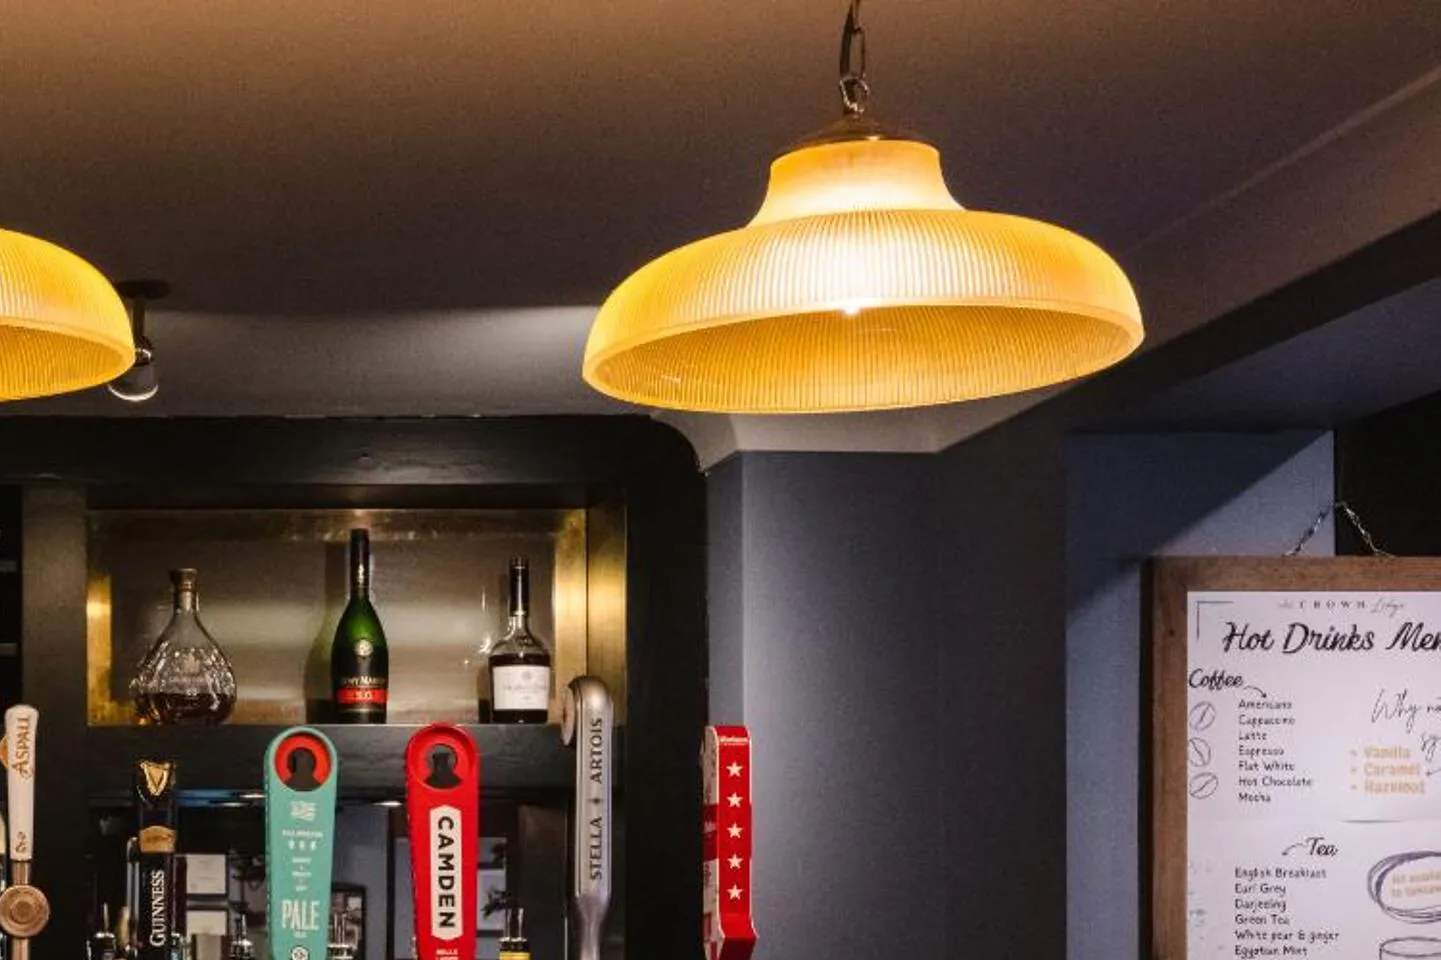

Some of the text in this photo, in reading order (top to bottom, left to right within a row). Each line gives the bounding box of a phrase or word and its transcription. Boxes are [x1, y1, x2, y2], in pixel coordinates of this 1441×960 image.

[1222, 622, 1275, 652] Hot
[1282, 622, 1375, 654] Drinks
[1188, 668, 1244, 690] Coffee
[1238, 699, 1292, 709] Americano
[1371, 688, 1419, 734] Why
[1239, 731, 1267, 741] Latte
[11, 716, 32, 779] ASPALL
[1239, 745, 1284, 758] Espresso
[1239, 760, 1295, 771] Flat White
[1364, 761, 1420, 776] Caramel
[1239, 776, 1311, 787] Hot Chocolate
[589, 717, 603, 881] STELLA ARTOIS
[1239, 792, 1271, 802] Mocha
[1305, 837, 1338, 857] Tea
[437, 815, 456, 929] CAMDEN
[1235, 867, 1326, 881] English Breakfast
[1235, 883, 1286, 898] Earl Grey
[149, 869, 165, 948] GUINNESS
[1235, 898, 1286, 913] Darjeeling
[281, 899, 320, 930] PALE
[1235, 914, 1290, 925] Green Tea
[1235, 929, 1267, 940] White
[1282, 945, 1308, 956] Mint
